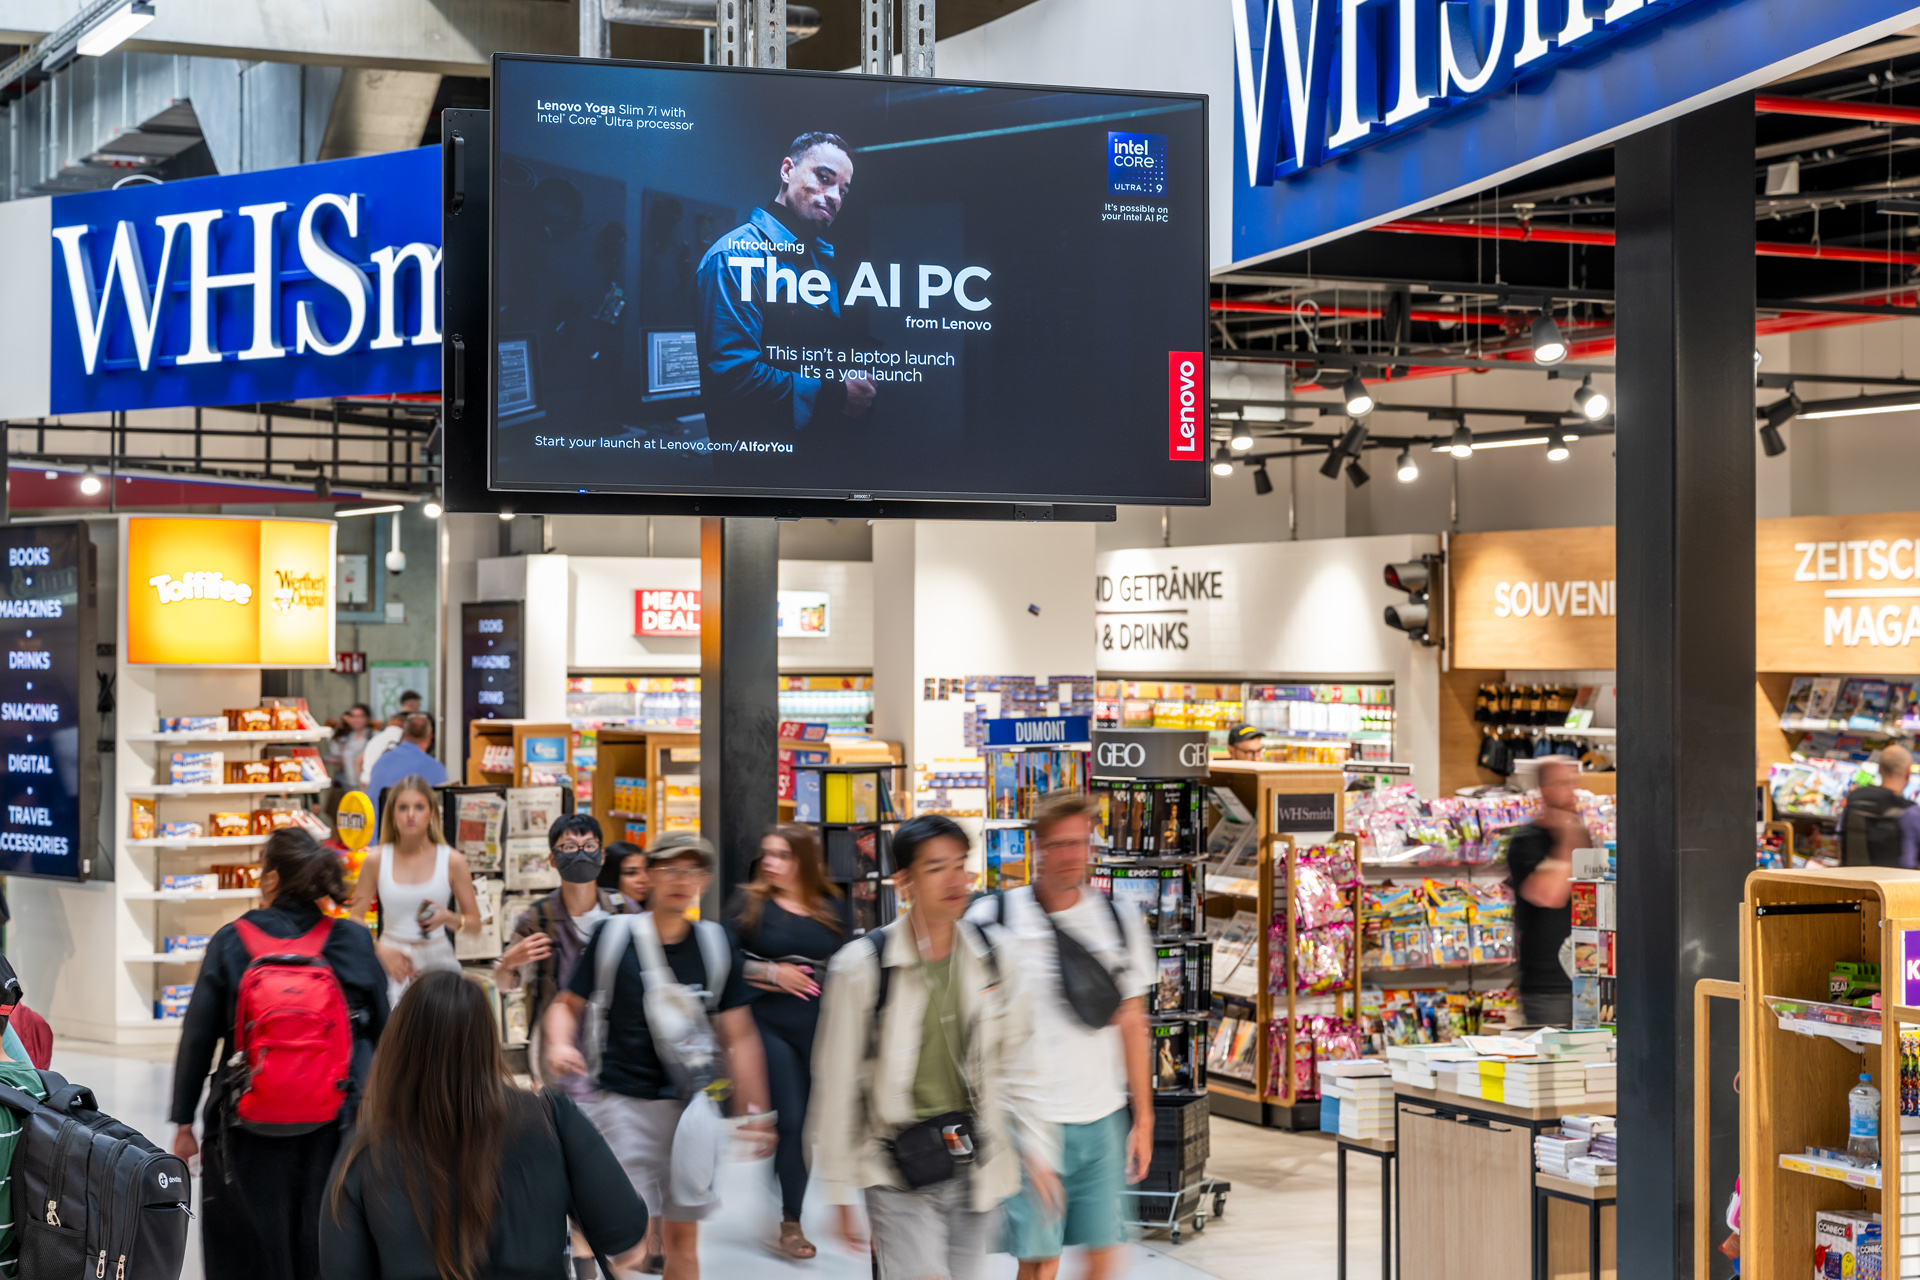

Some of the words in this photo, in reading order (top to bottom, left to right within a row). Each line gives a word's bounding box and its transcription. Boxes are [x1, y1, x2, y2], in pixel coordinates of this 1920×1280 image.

[537, 99, 582, 112] Lenovo
[585, 102, 616, 115] Yoga
[619, 104, 644, 116] Slim
[647, 105, 658, 116] 7i
[660, 106, 686, 118] with
[605, 116, 633, 128] Ultra
[637, 118, 694, 130] processor
[1114, 138, 1148, 156] intel
[1114, 183, 1142, 191] ULTRA
[1156, 184, 1163, 193] 9
[1101, 213, 1122, 222] your
[1123, 213, 1142, 222] Intel
[1144, 214, 1154, 222] AI
[1156, 214, 1168, 222] PC
[1104, 203, 1118, 212] It's
[1120, 204, 1155, 213] possible
[728, 238, 805, 254] Introducing
[728, 256, 831, 305] The
[843, 261, 901, 308] AI
[918, 264, 993, 312] PC
[905, 315, 938, 329] from
[942, 317, 992, 331] Lenovo
[766, 346, 798, 361] This
[802, 346, 833, 362] isn't
[837, 352, 846, 362] a
[850, 348, 900, 367] laptop
[904, 350, 955, 366] launch
[800, 364, 821, 379] It's
[825, 369, 834, 380] a
[838, 369, 868, 383] you
[872, 366, 922, 382] launch
[1176, 360, 1196, 452] Lenovo
[534, 435, 566, 448] Start
[568, 439, 597, 452] your
[600, 436, 640, 450] launch
[644, 440, 656, 450] at
[659, 438, 793, 454] Lenovo.com/AIforYou
[8, 546, 50, 566] BOOKS
[1120, 566, 1223, 602] GETRÄNKE
[0, 599, 63, 618] MAGAZINES
[642, 591, 700, 611] MEAL
[1495, 580, 1616, 618] SOUVENI
[642, 610, 700, 631] DEAL
[1824, 604, 1920, 648] MAGA
[1102, 623, 1114, 651] &
[1120, 622, 1190, 651] DRINKS
[8, 650, 52, 670] DRINKS
[0, 702, 60, 723] SNACKING
[1015, 720, 1066, 743] DUMONT
[8, 753, 54, 774] DIGITAL
[1096, 742, 1146, 768] GEO
[8, 804, 54, 826] TRAVEL
[1278, 806, 1334, 820] WHSmith
[0, 832, 70, 856] CCESSORIES
[1907, 960, 1920, 980] K
[1818, 1220, 1846, 1238] CONNECT
[1844, 1224, 1852, 1240] 4
